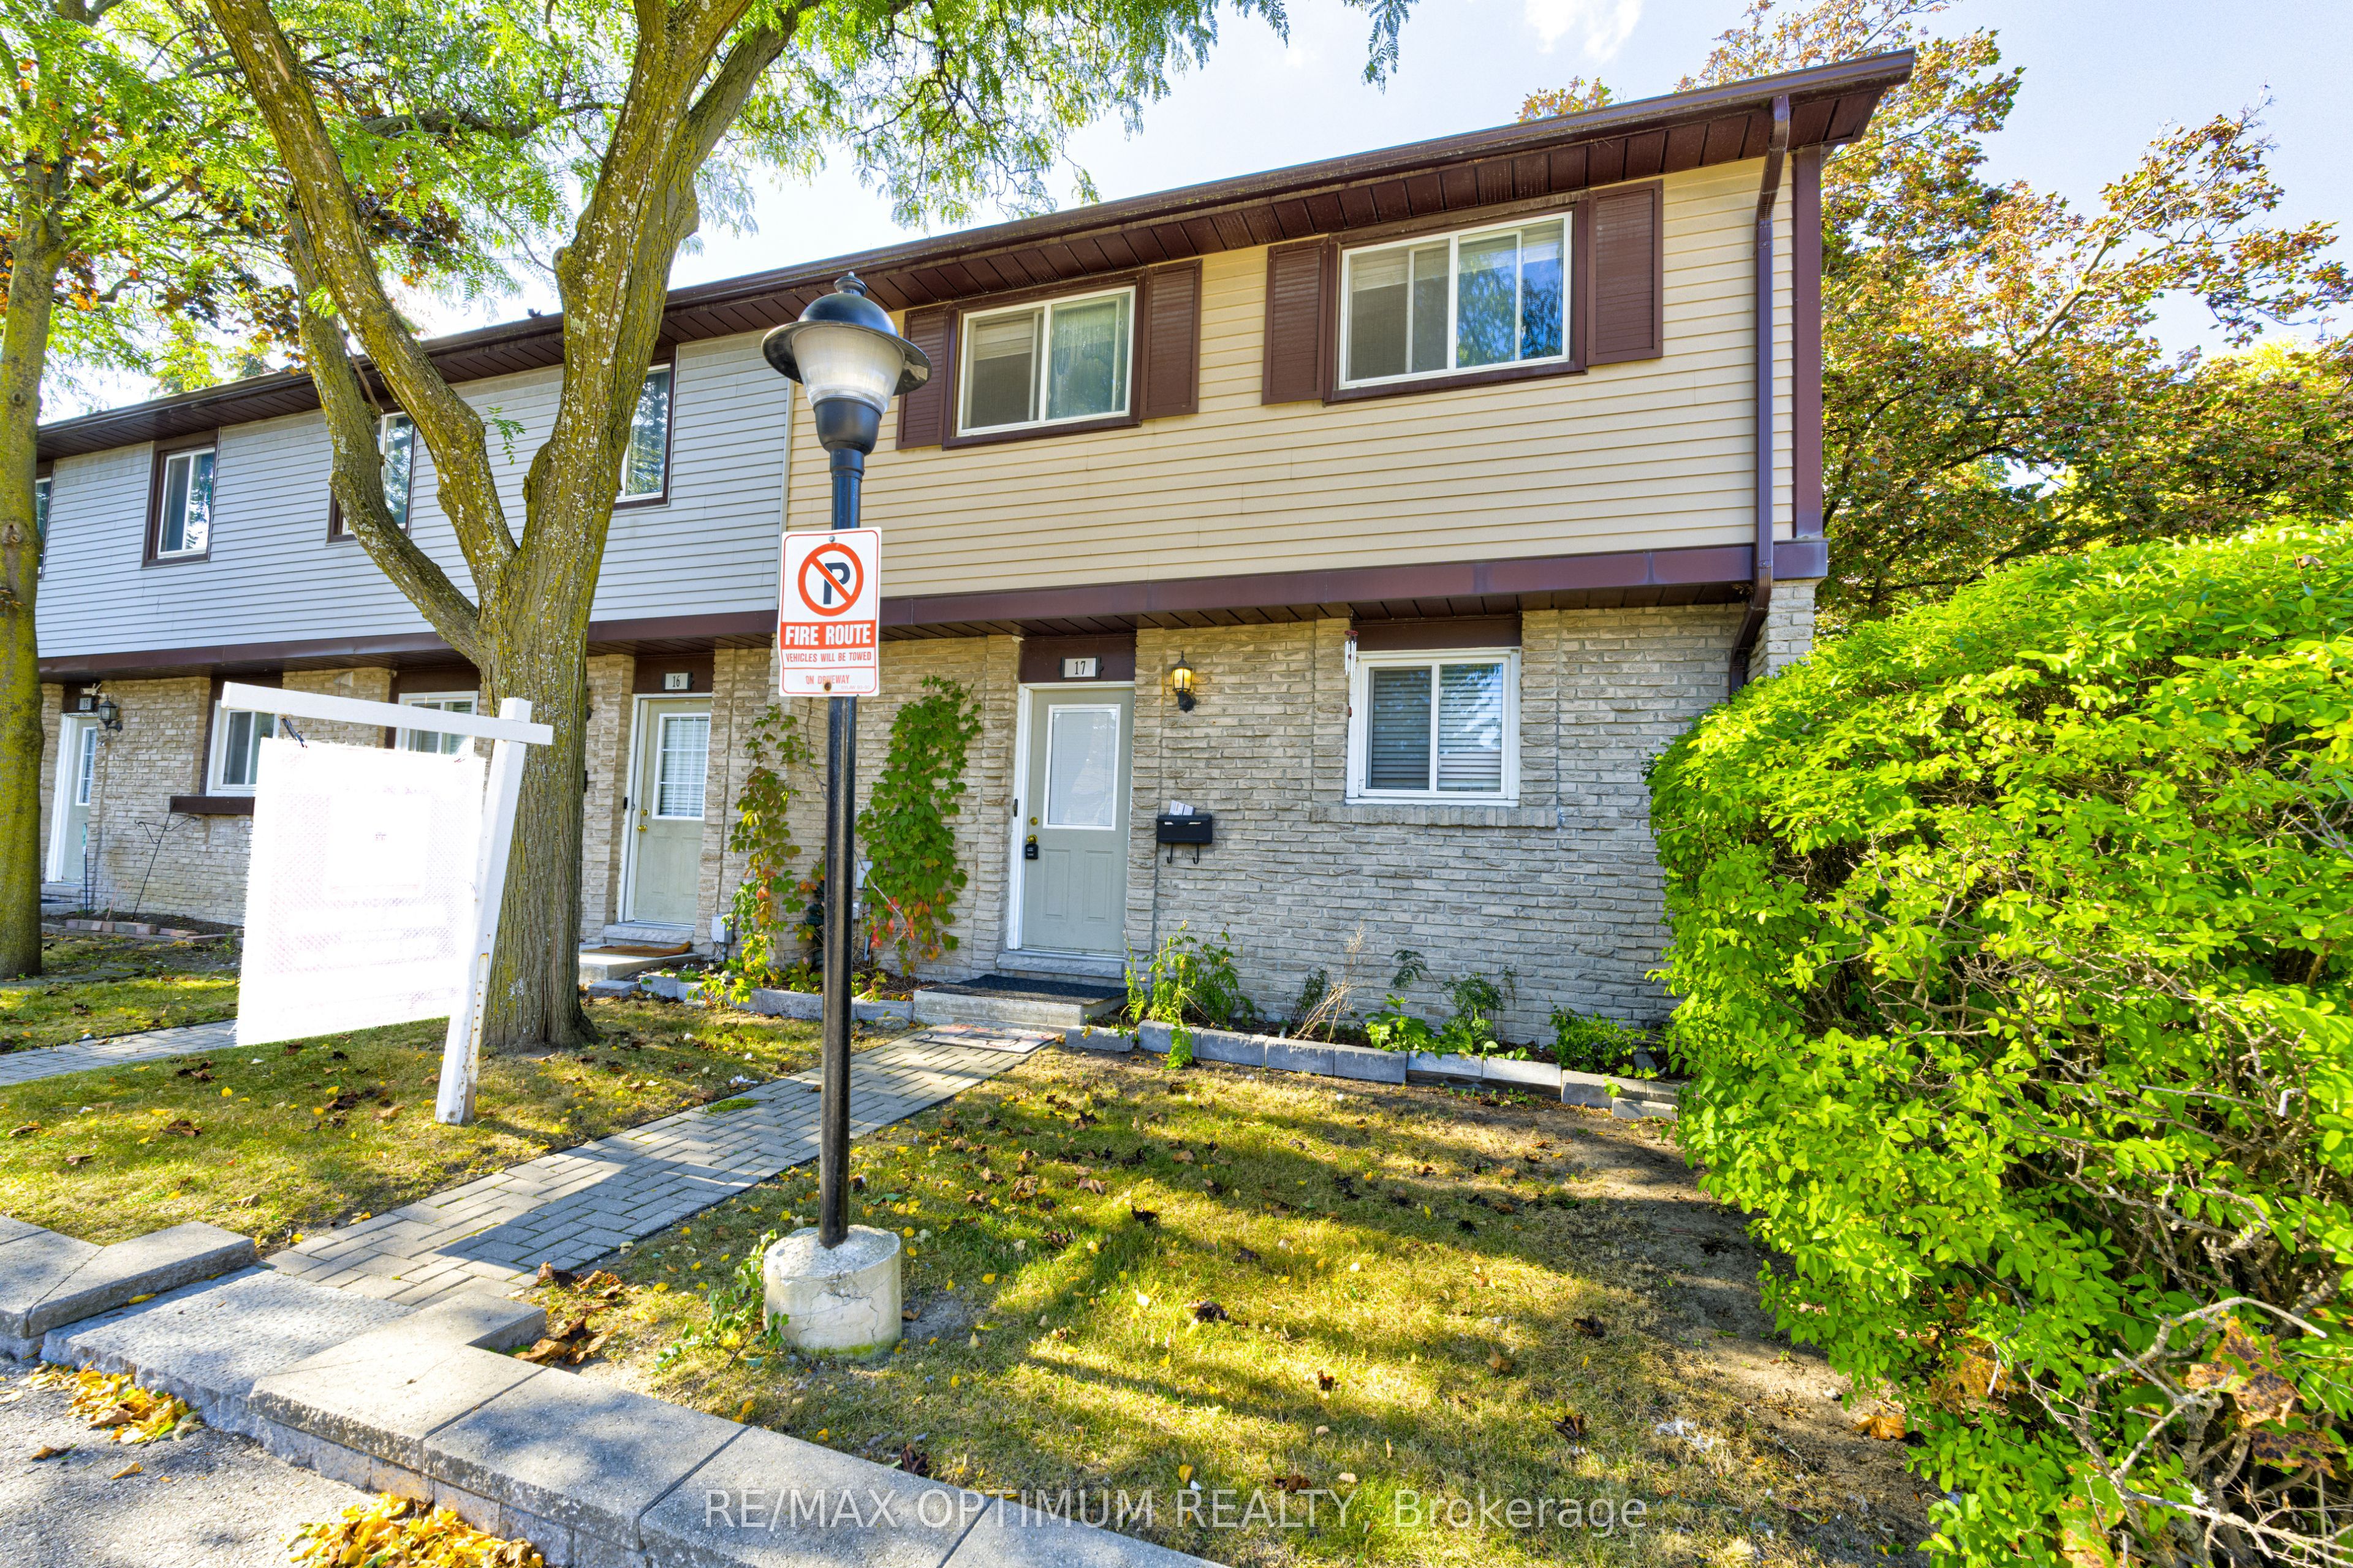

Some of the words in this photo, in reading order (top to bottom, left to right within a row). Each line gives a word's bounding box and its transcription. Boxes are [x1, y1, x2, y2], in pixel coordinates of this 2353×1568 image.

[823, 562, 851, 605] P
[785, 625, 819, 646] FIRE
[825, 623, 871, 645] ROUTE
[786, 653, 817, 662] VEHICLES
[820, 653, 835, 662] WILL
[838, 652, 846, 662] BE
[849, 651, 871, 661] TOWED
[1075, 661, 1086, 675] 17
[672, 675, 680, 687] 16
[805, 675, 814, 684] ON
[83, 699, 89, 708] 15
